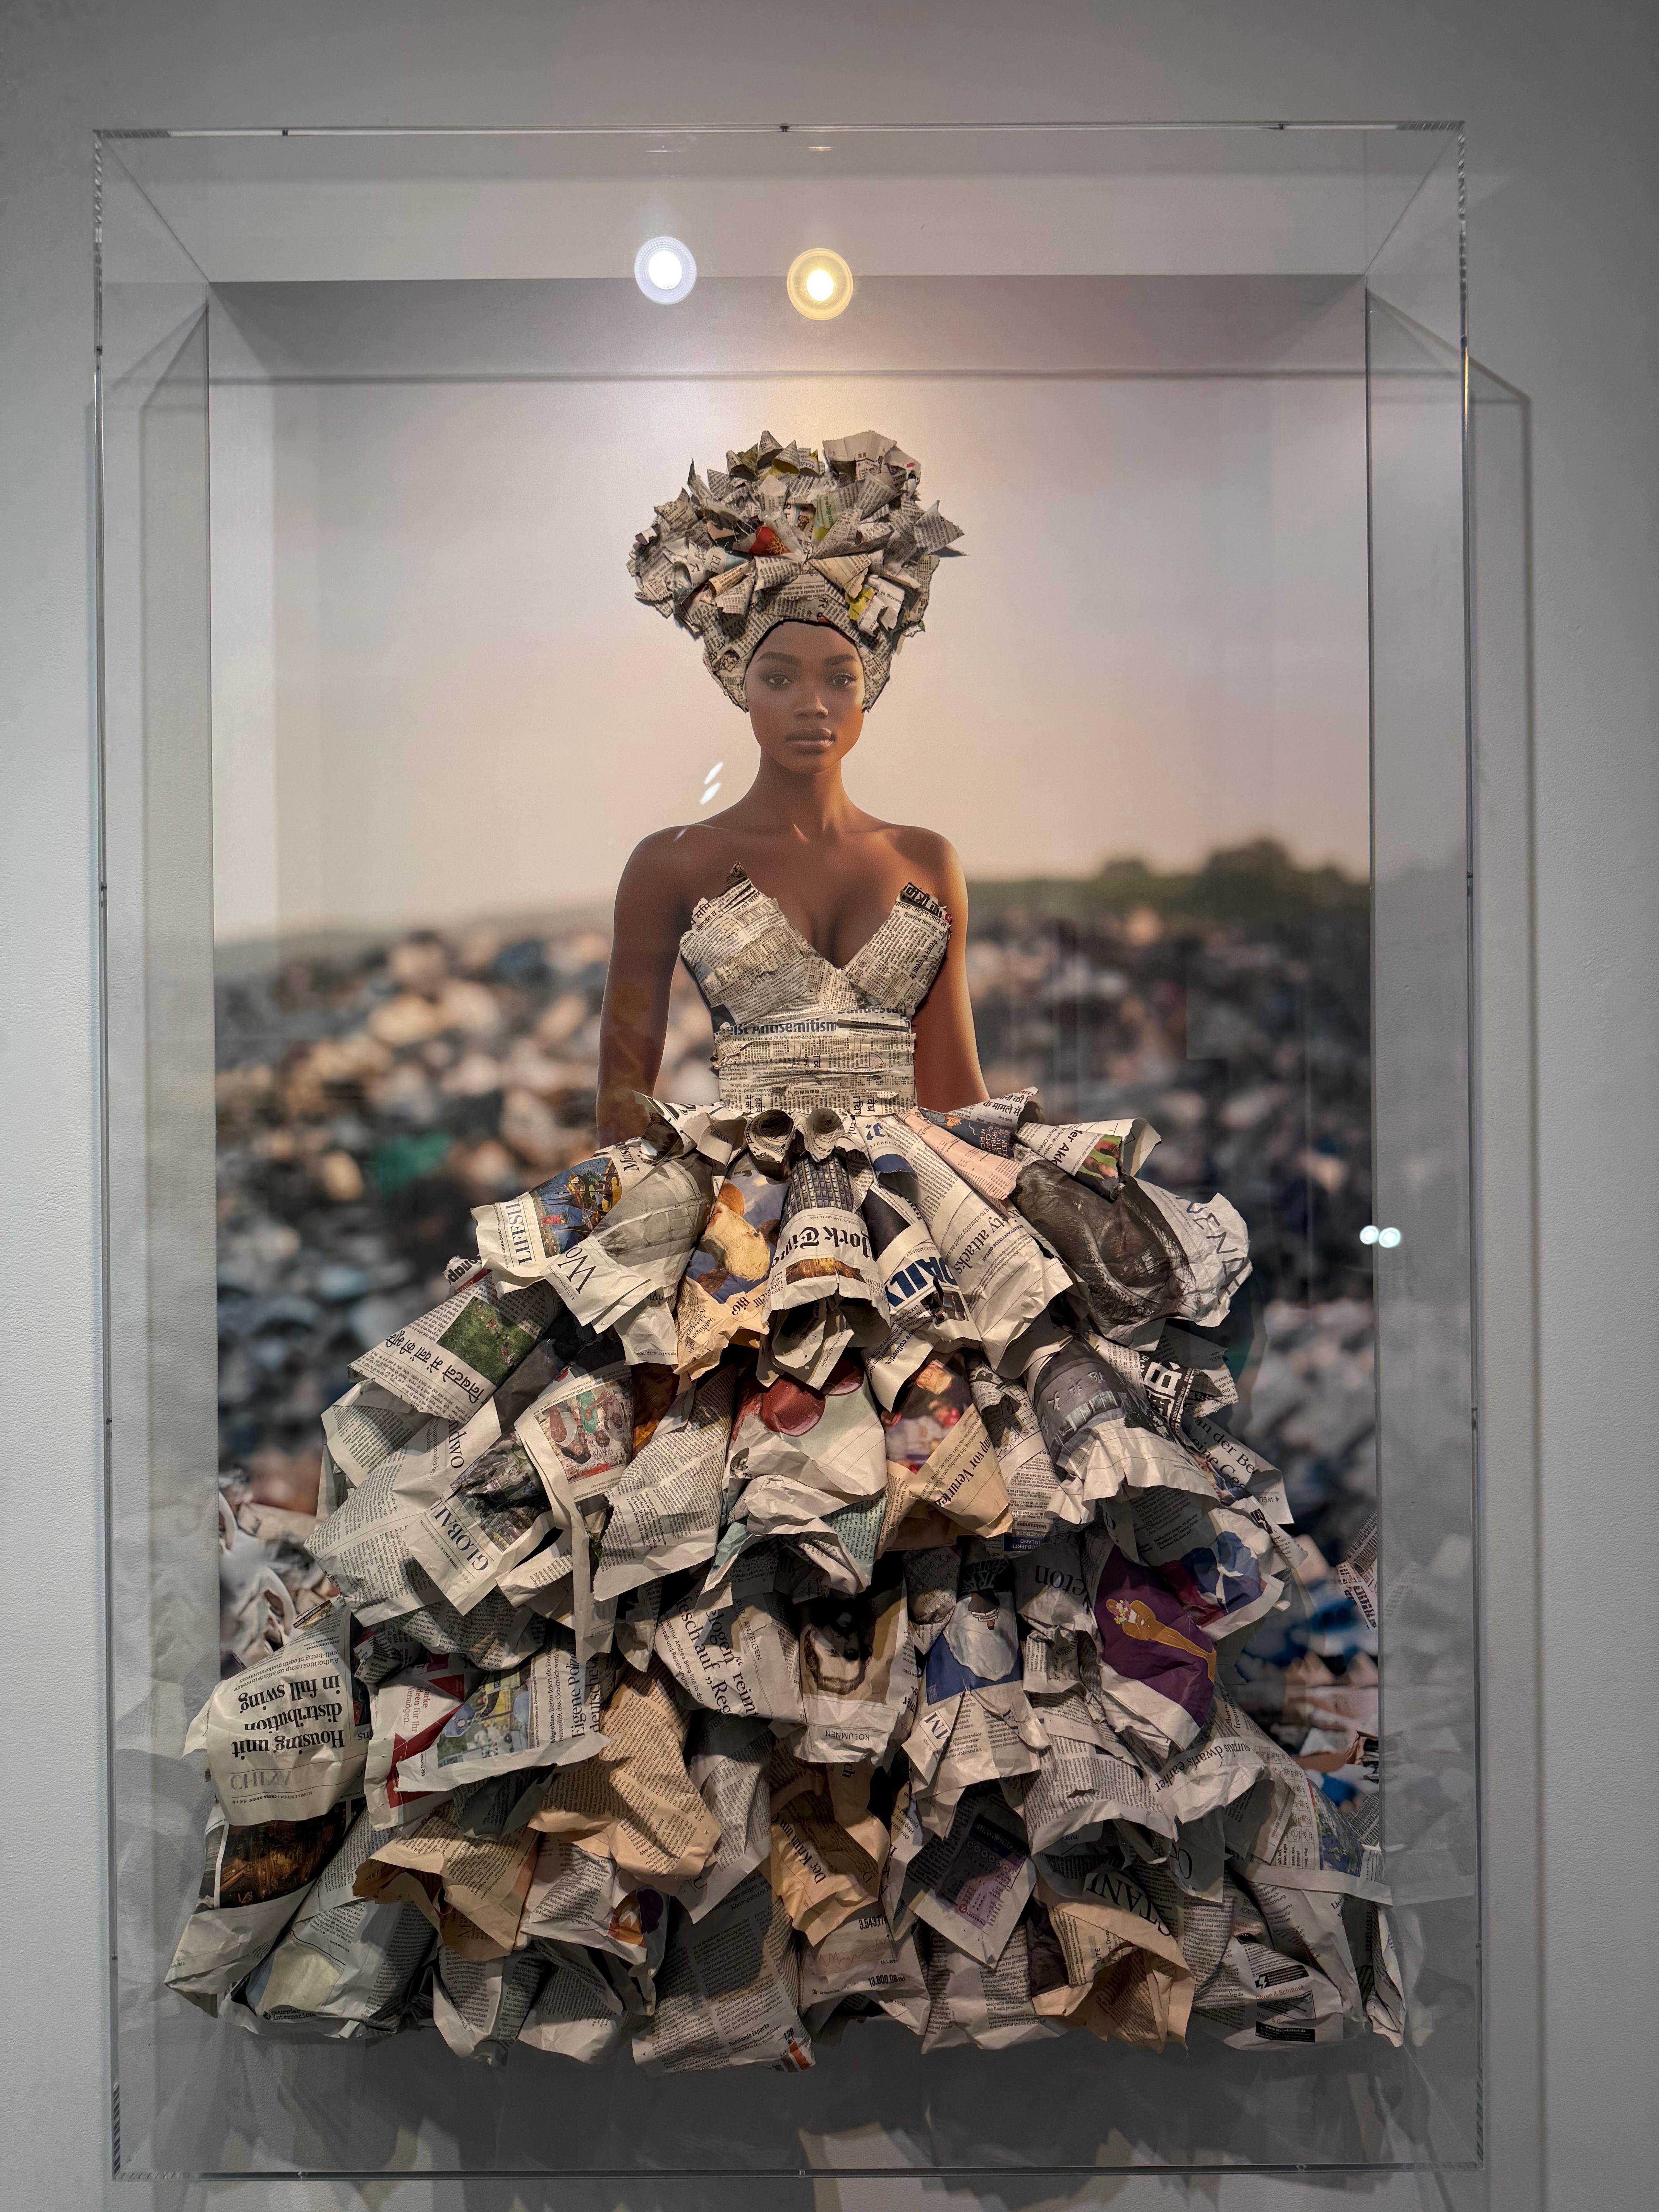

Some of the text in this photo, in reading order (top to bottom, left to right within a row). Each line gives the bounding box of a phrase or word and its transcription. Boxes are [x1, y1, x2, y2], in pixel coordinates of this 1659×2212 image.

[963, 1216, 981, 1235] identify
[821, 1225, 870, 1258] York
[954, 1233, 964, 1247] itself
[953, 1230, 989, 1274] attacks
[885, 1258, 956, 1306] DAILY
[1211, 1430, 1236, 1454] der
[944, 1453, 954, 1464] Wahl
[948, 1453, 962, 1468] Berichts
[969, 1451, 984, 1470] vor
[930, 1469, 940, 1480] Jahres
[434, 1504, 488, 1570] GLOBAL
[440, 1547, 459, 1570] CHINA DAILY
[674, 1595, 704, 1640] fesch
[695, 1640, 720, 1671] auf
[741, 1620, 761, 1660] ANZEIGEN
[305, 1650, 339, 1662] well-being
[675, 1640, 685, 1660] Andrea
[285, 1663, 302, 1673] ramp
[303, 1657, 339, 1668] Authorities
[234, 1680, 252, 1691] ensure
[257, 1670, 276, 1681] efforts
[553, 1669, 562, 1698] Österreich
[237, 1674, 341, 1714] in full swing
[401, 1686, 414, 1725] Vermögen.
[422, 1686, 431, 1708] Starke
[585, 1669, 603, 1733] deutsche
[242, 1702, 343, 1736] distribution
[411, 1686, 422, 1733] Ideen für Ihr
[568, 1688, 587, 1738] Eigene
[548, 1712, 557, 1743] Migration.
[556, 1712, 565, 1741] bezweifelt
[825, 1730, 869, 1740] KOLUMNEN
[230, 1728, 345, 1761] Housing unit
[645, 1750, 655, 1764] Donald
[1186, 1746, 1222, 1770] dwarfs
[1156, 1760, 1185, 1791] earlier
[894, 1815, 914, 1834] Hegseth
[788, 1834, 812, 1865] Krimi
[810, 1862, 826, 1884] Der
[730, 1889, 766, 1910] Konsequenzen
[1279, 1985, 1304, 1995] Schmuck
[729, 2023, 769, 2046] Russlands Exporte
